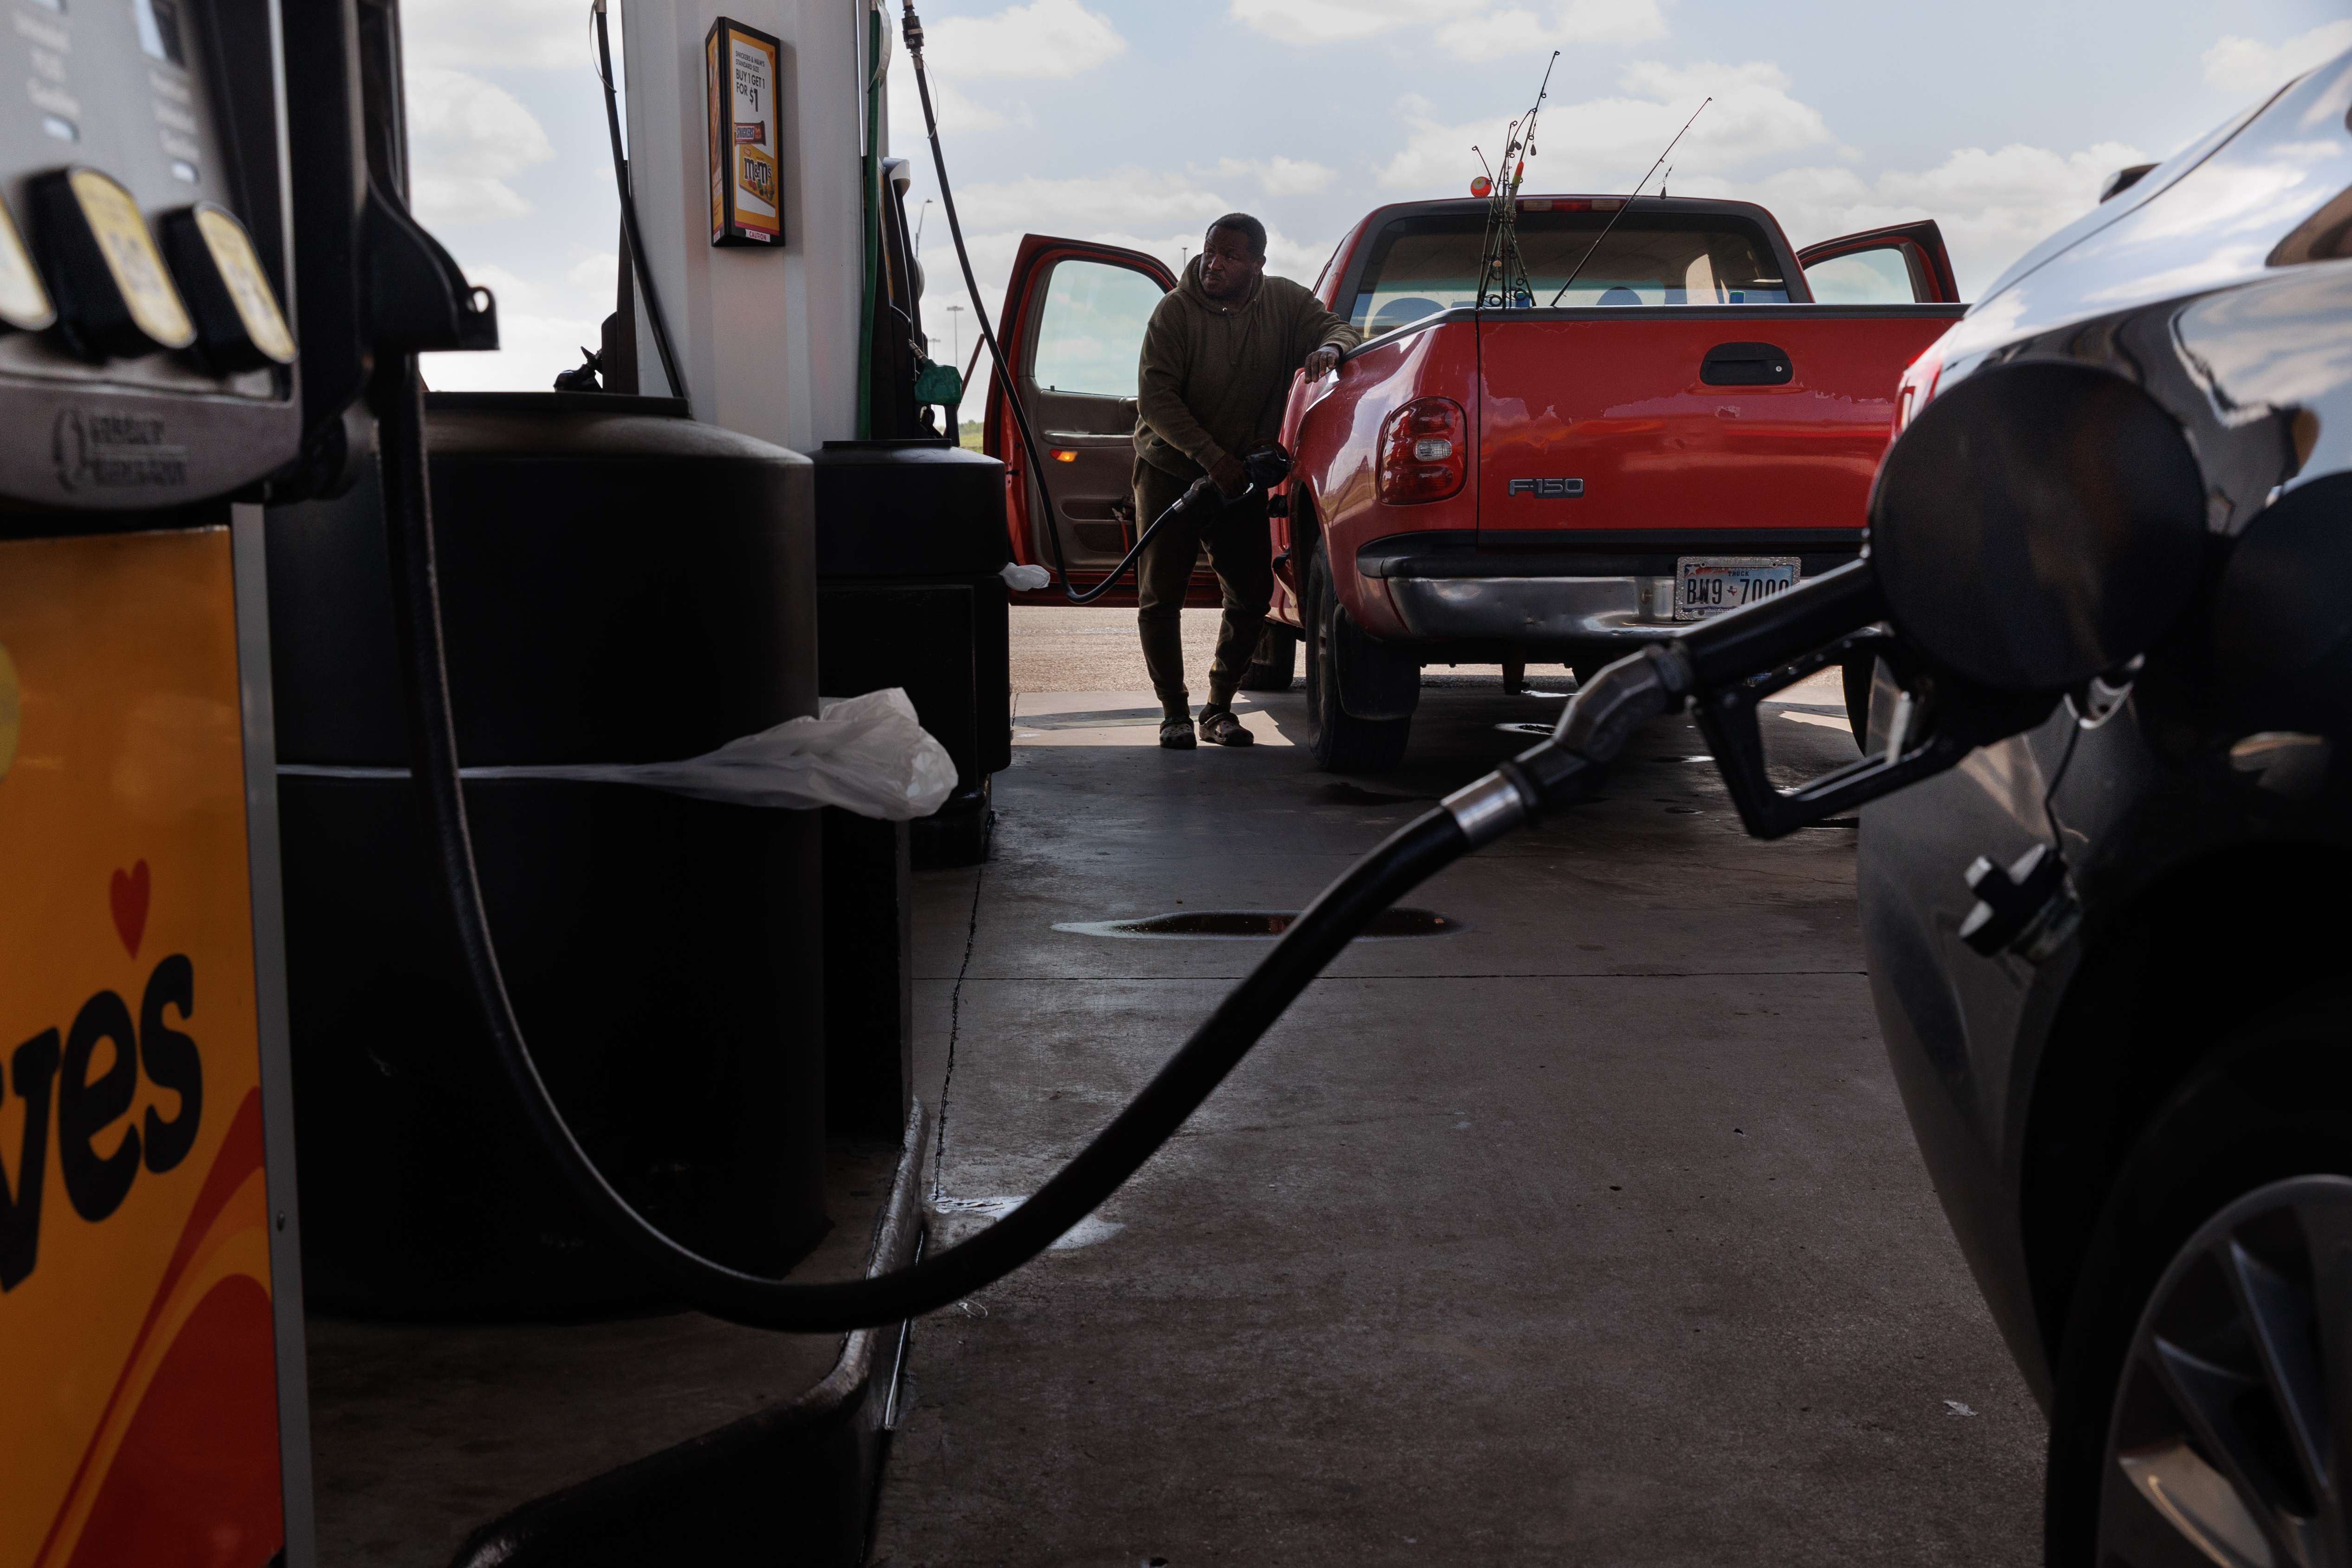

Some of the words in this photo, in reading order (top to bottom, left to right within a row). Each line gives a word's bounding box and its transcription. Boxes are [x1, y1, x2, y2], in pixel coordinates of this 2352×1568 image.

[736, 51, 750, 61] SNICKERS
[736, 59, 752, 70] STANDARD
[736, 69, 748, 82] BUY
[748, 73, 750, 84] 1
[751, 75, 762, 87] GET
[762, 78, 765, 89] 1
[737, 82, 748, 96] FOR
[750, 87, 758, 112] $1
[749, 231, 767, 241] CAUTION
[1510, 478, 1583, 495] F-150
